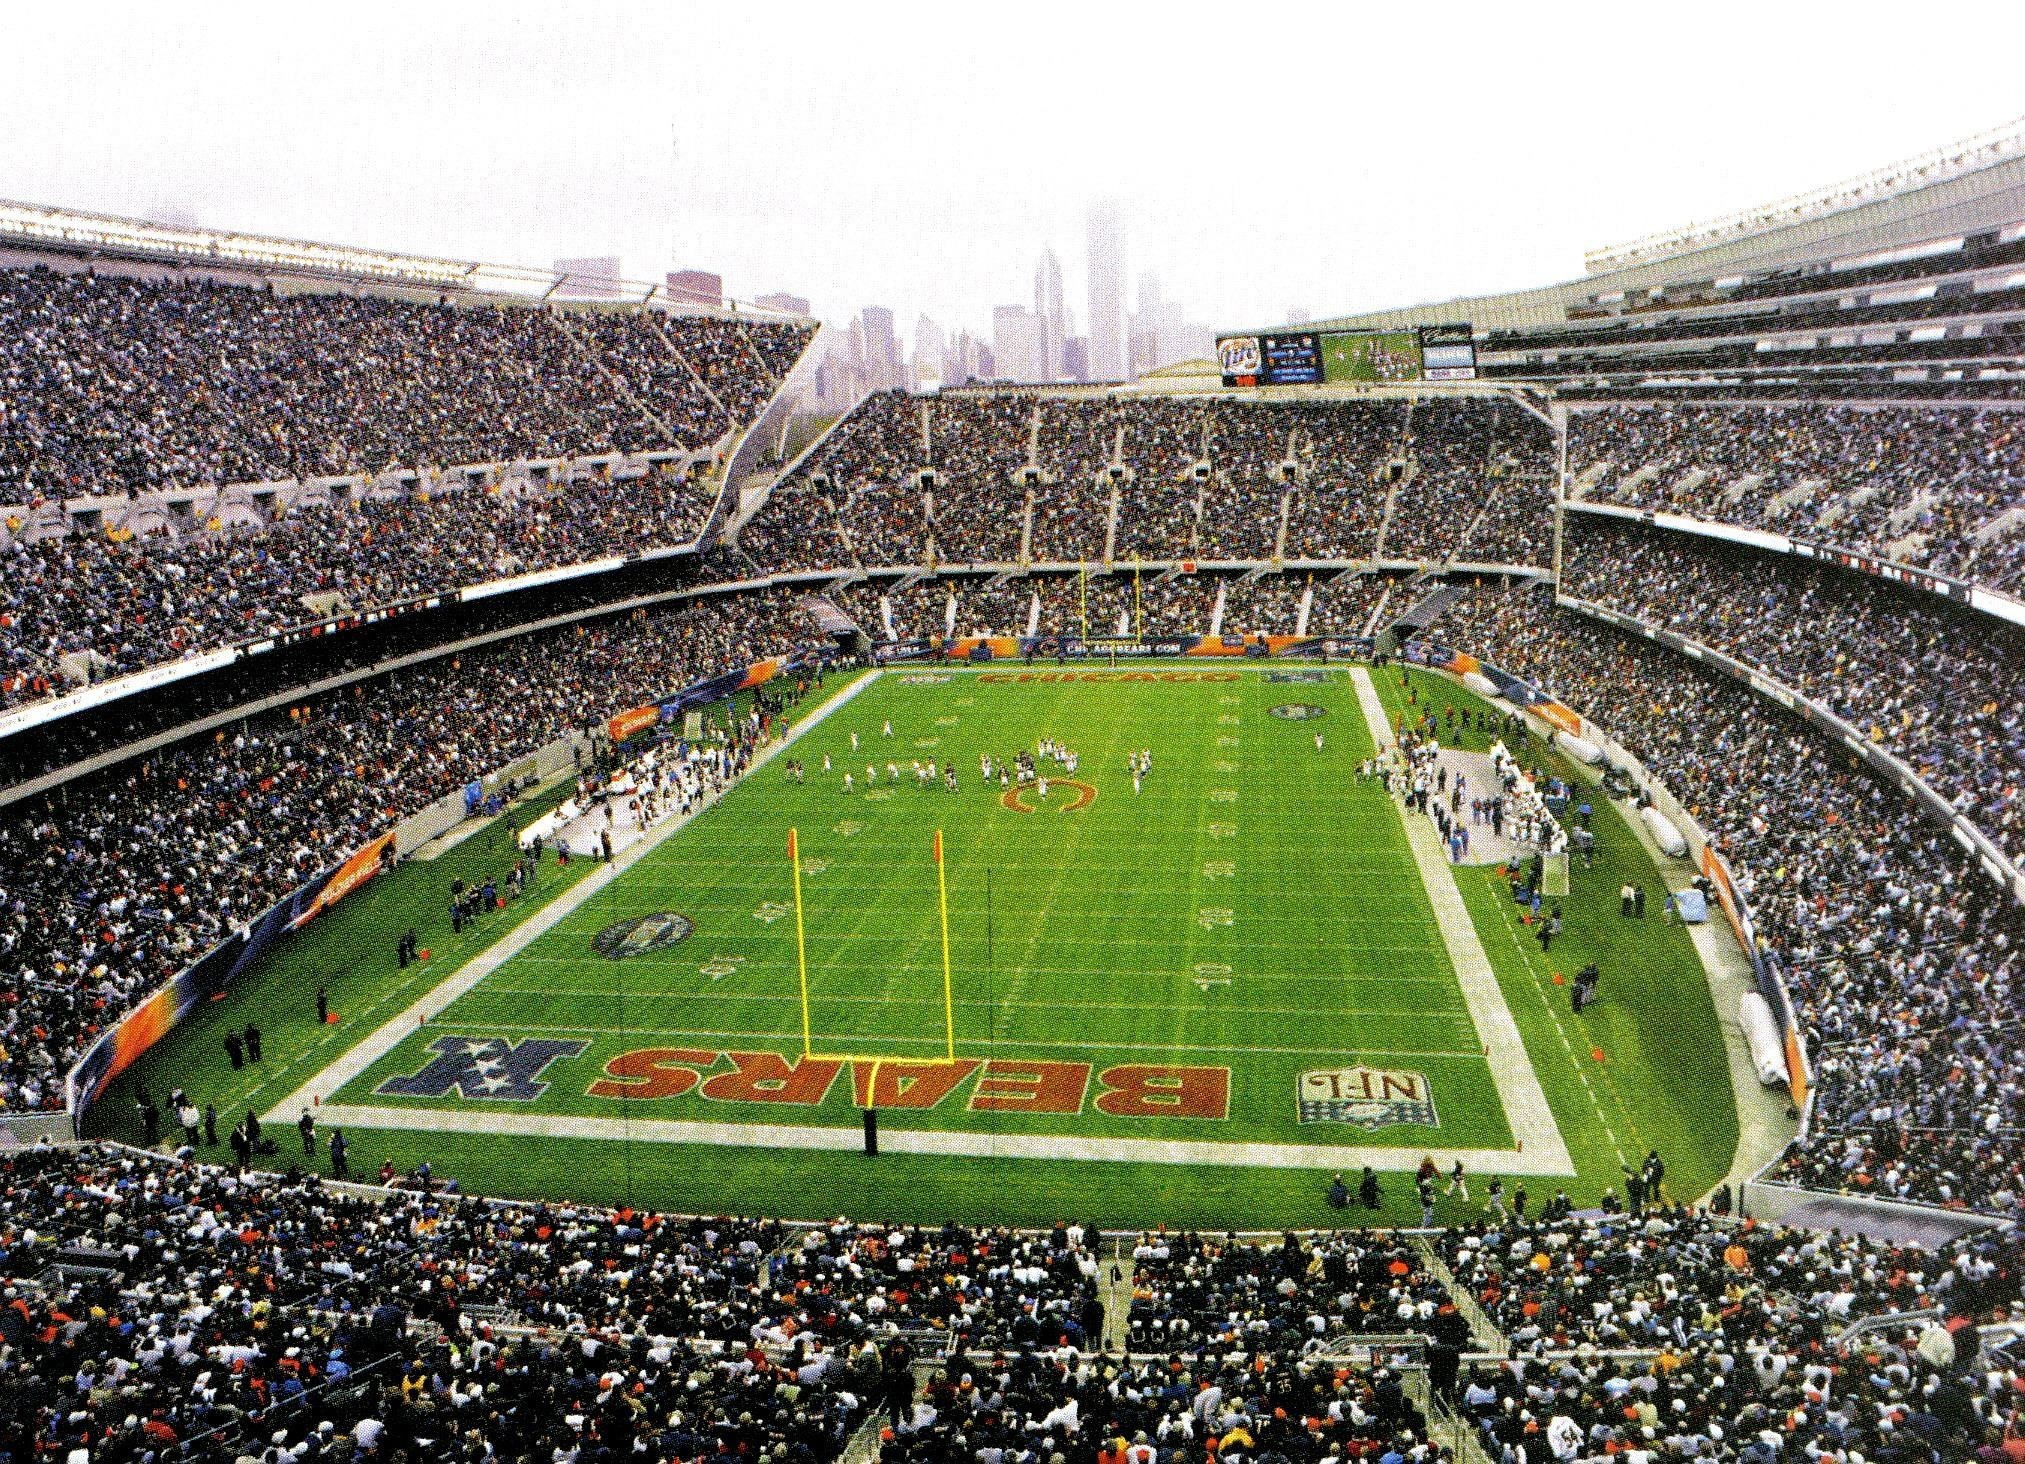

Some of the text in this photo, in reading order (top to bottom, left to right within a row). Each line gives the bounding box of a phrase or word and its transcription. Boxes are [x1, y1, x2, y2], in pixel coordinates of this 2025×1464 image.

[978, 671, 1241, 683] CHICAGO
[1194, 962, 1233, 984] 10
[587, 1047, 1231, 1120] BEARS
[1308, 1071, 1420, 1101] NFL
